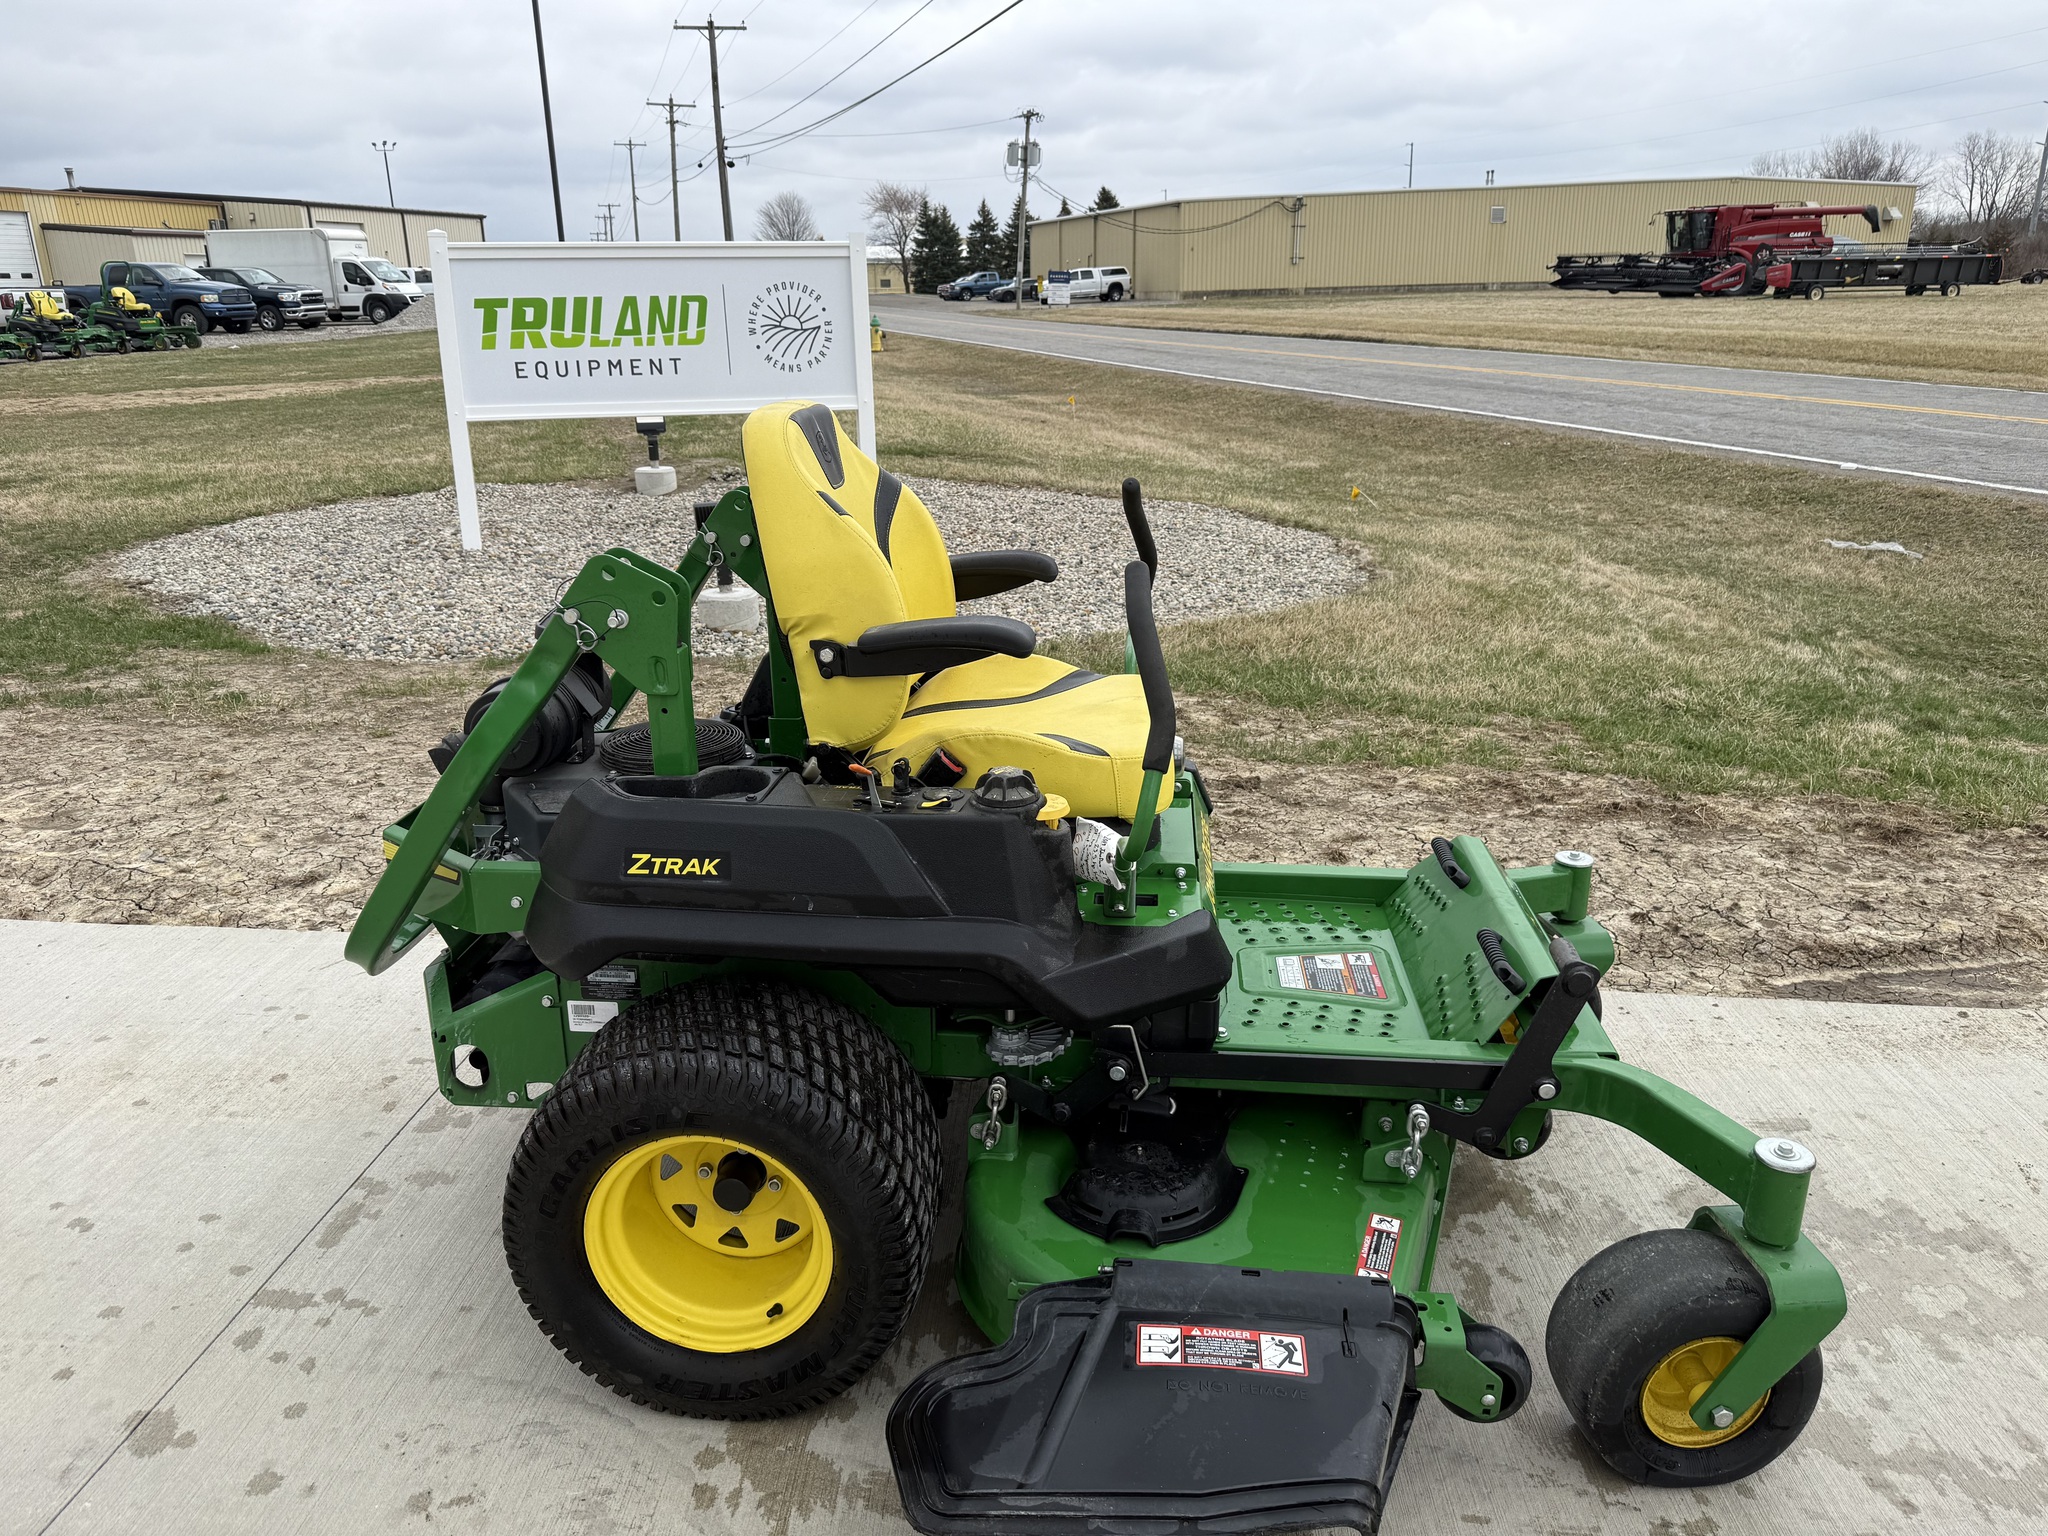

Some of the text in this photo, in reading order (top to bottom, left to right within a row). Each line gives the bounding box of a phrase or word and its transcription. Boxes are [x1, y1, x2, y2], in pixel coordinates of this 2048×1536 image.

[473, 295, 708, 351] TRULAND
[748, 281, 822, 336] WHERE PROVIDER
[515, 357, 682, 380] EQUIPMENT
[764, 320, 833, 373] MEANS PARTNER
[627, 853, 721, 875] ZTRAK
[538, 1111, 711, 1219] CARLISLE
[830, 1264, 869, 1357] TURF
[1204, 1329, 1250, 1339] DANGER
[654, 1352, 827, 1402] MASTER
[1166, 1378, 1309, 1401] DO NOT REMOVE
